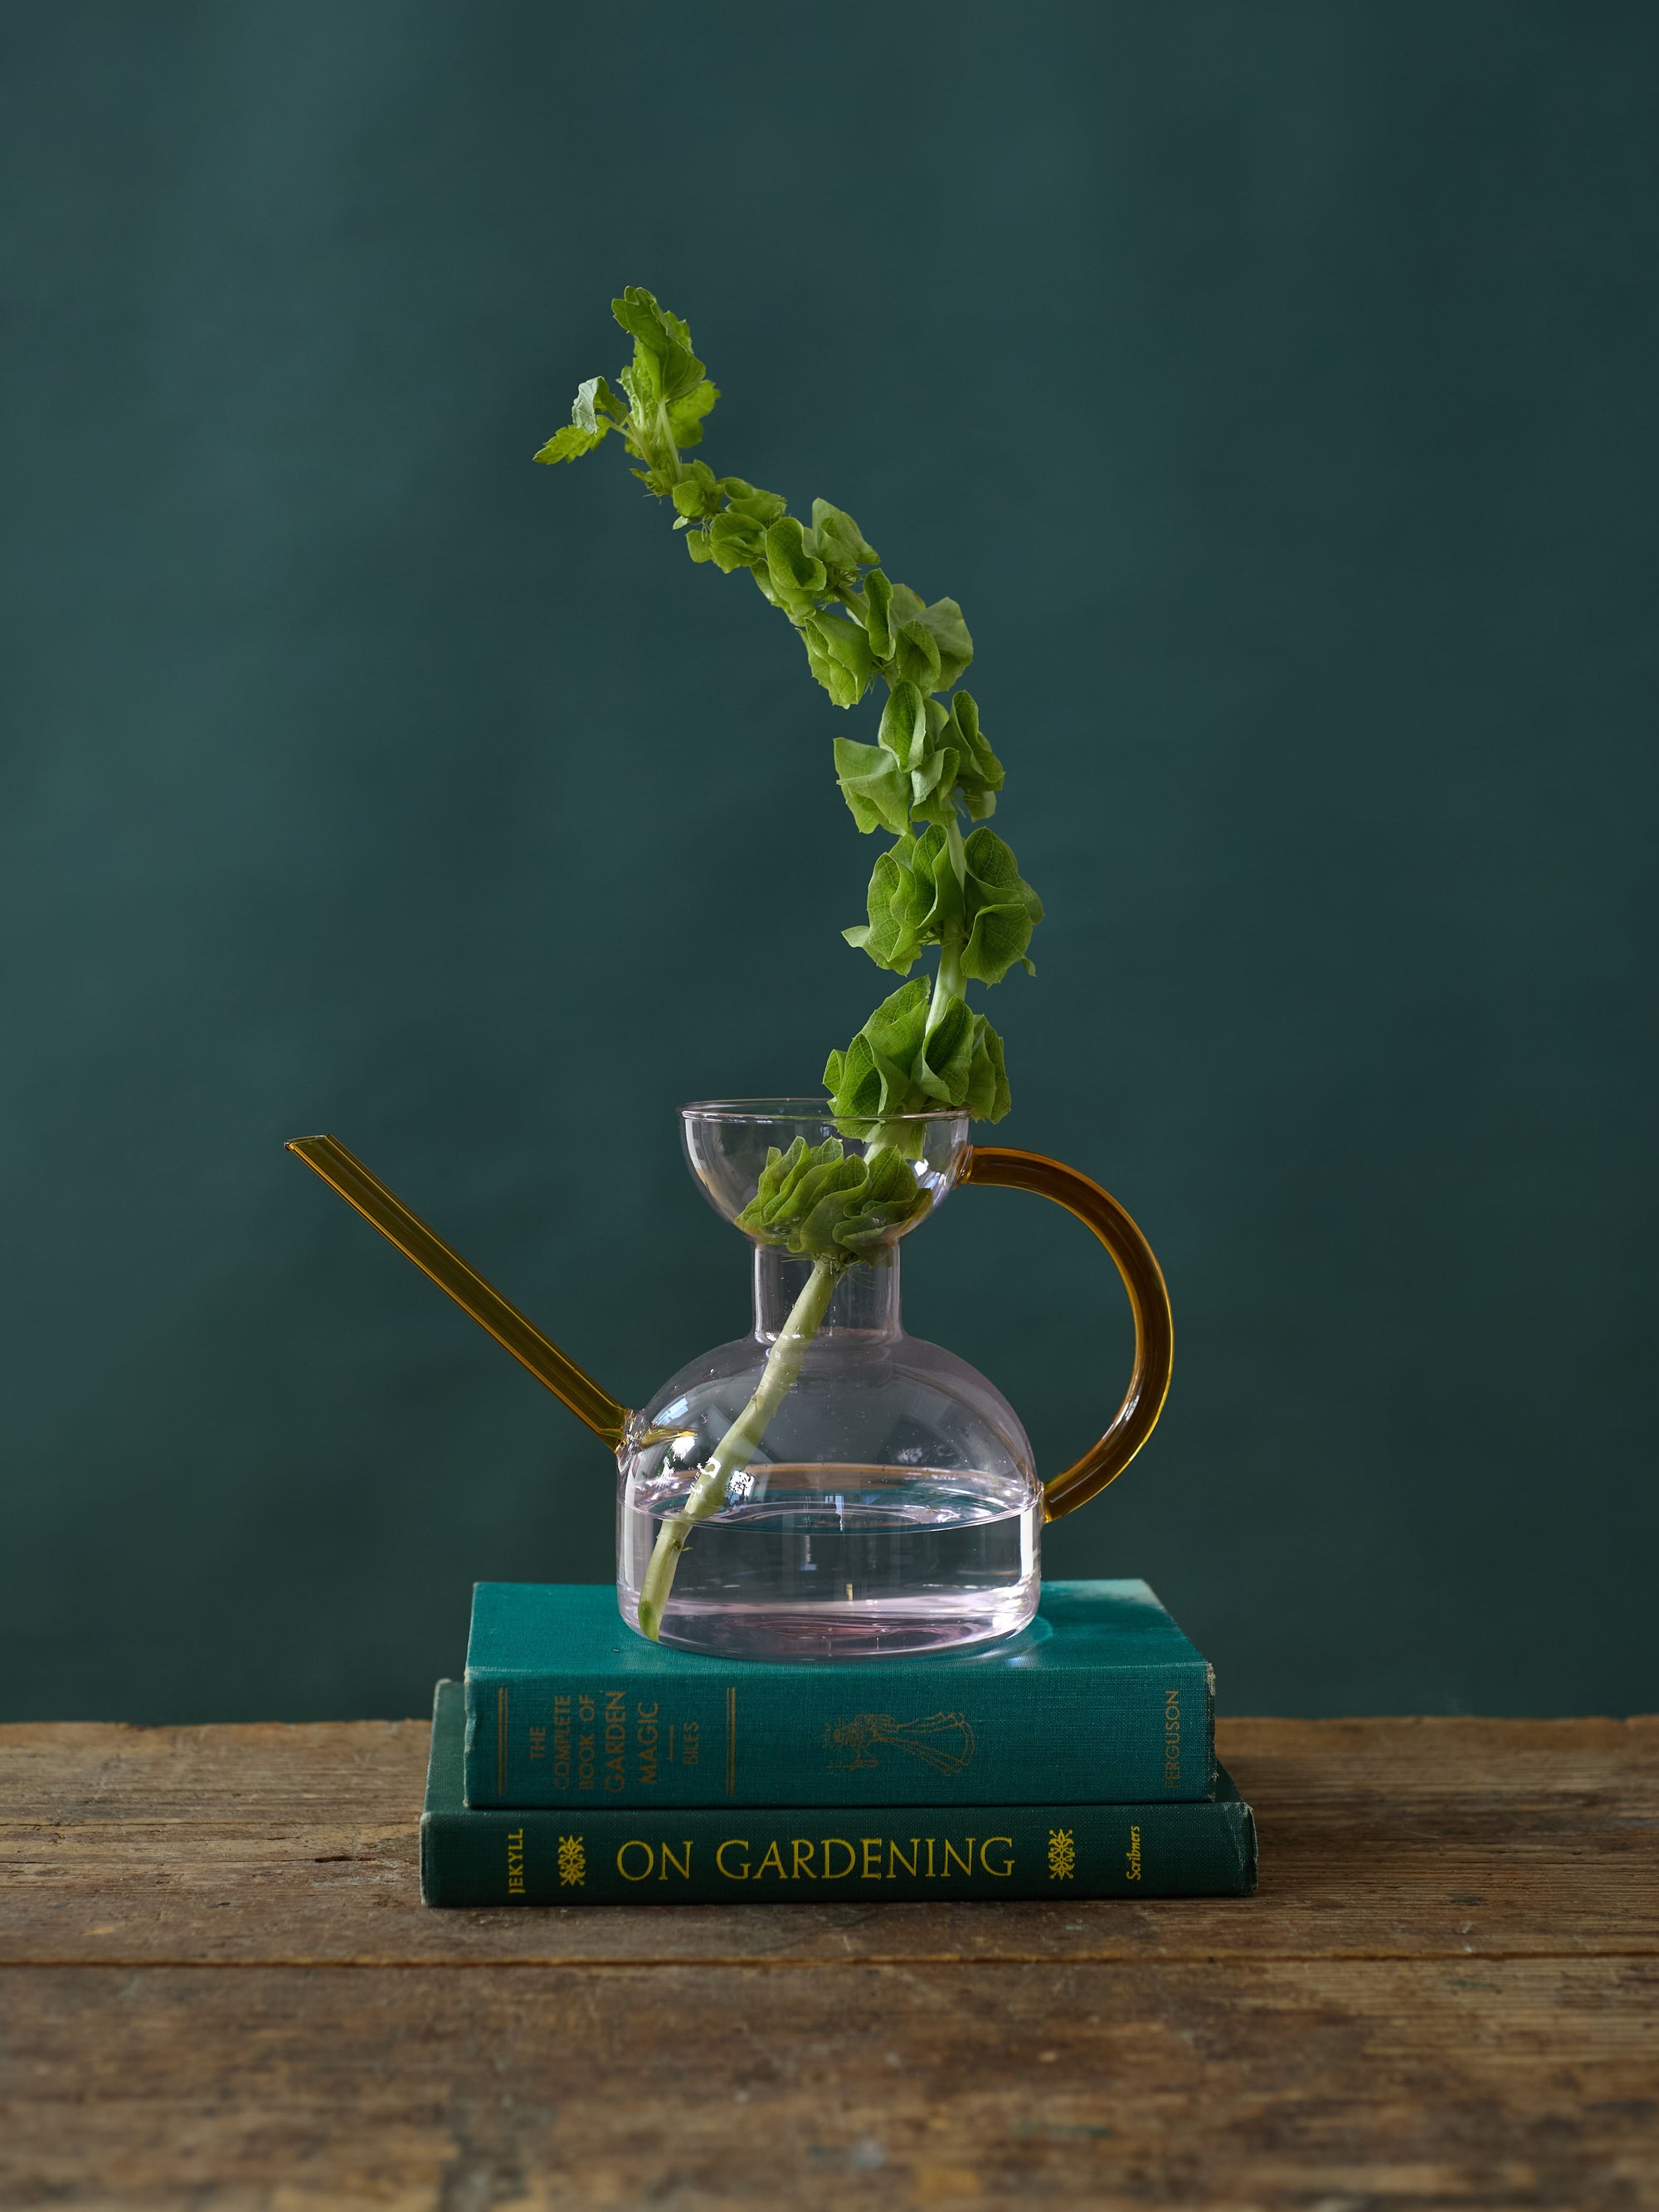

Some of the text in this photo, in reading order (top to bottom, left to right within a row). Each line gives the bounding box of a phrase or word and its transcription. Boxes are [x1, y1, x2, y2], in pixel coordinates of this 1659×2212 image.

[529, 1726, 546, 1760] THE
[554, 1695, 571, 1791] COMPLETE
[578, 1693, 595, 1791] BOOK OF
[605, 1691, 626, 1792] GARDEN
[637, 1702, 659, 1784] MAGIC
[683, 1721, 699, 1765] BILES
[1165, 1690, 1180, 1788] FERGUSON
[508, 1828, 526, 1893] JEKYLL
[616, 1836, 1016, 1881] ON GARDENING
[1126, 1825, 1141, 1880] Scribners
